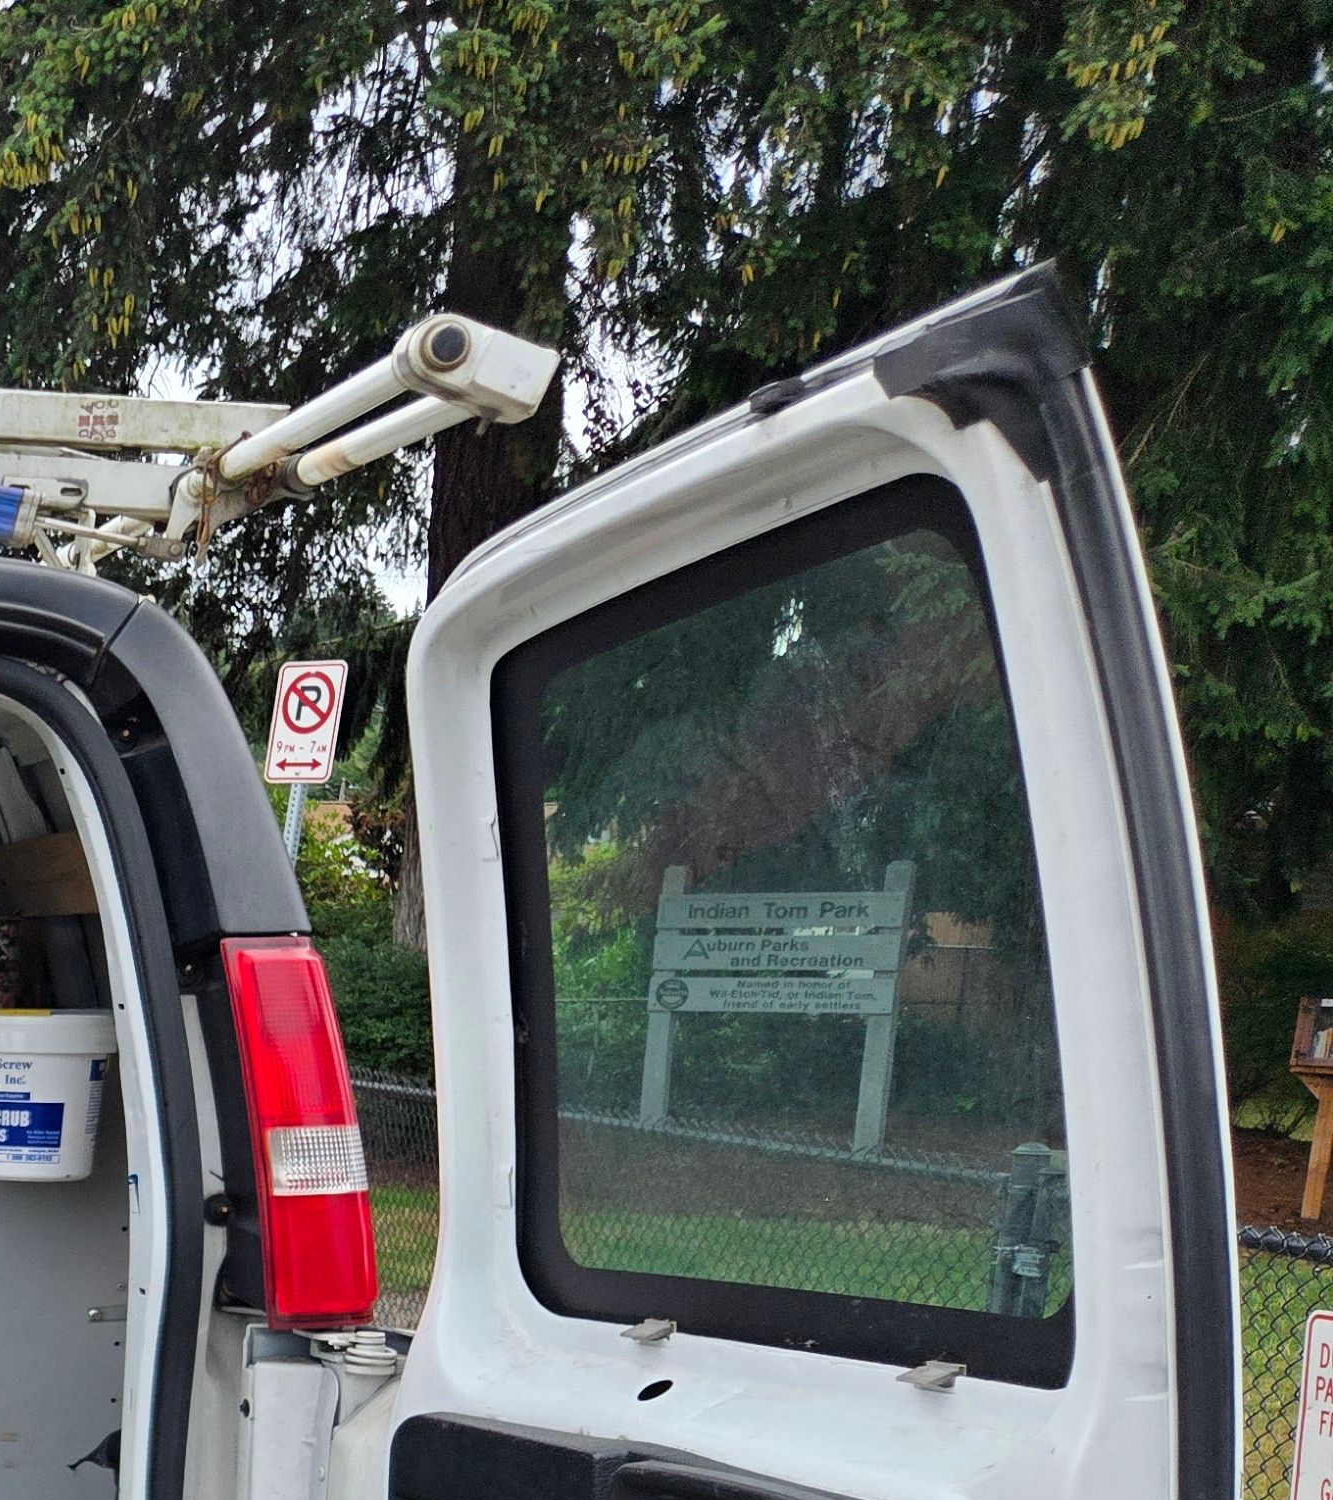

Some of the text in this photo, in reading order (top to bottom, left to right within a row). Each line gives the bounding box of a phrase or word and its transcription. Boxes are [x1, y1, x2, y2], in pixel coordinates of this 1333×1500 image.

[276, 741, 283, 753] 9
[284, 744, 296, 753] PM
[309, 741, 317, 753] 7
[316, 744, 327, 753] AM
[688, 901, 870, 920] Indian Tom Park
[683, 938, 809, 960] Auburn Parks
[730, 954, 864, 968] and Recreation
[736, 980, 851, 989] Named in honor of
[803, 990, 842, 1000] Indian
